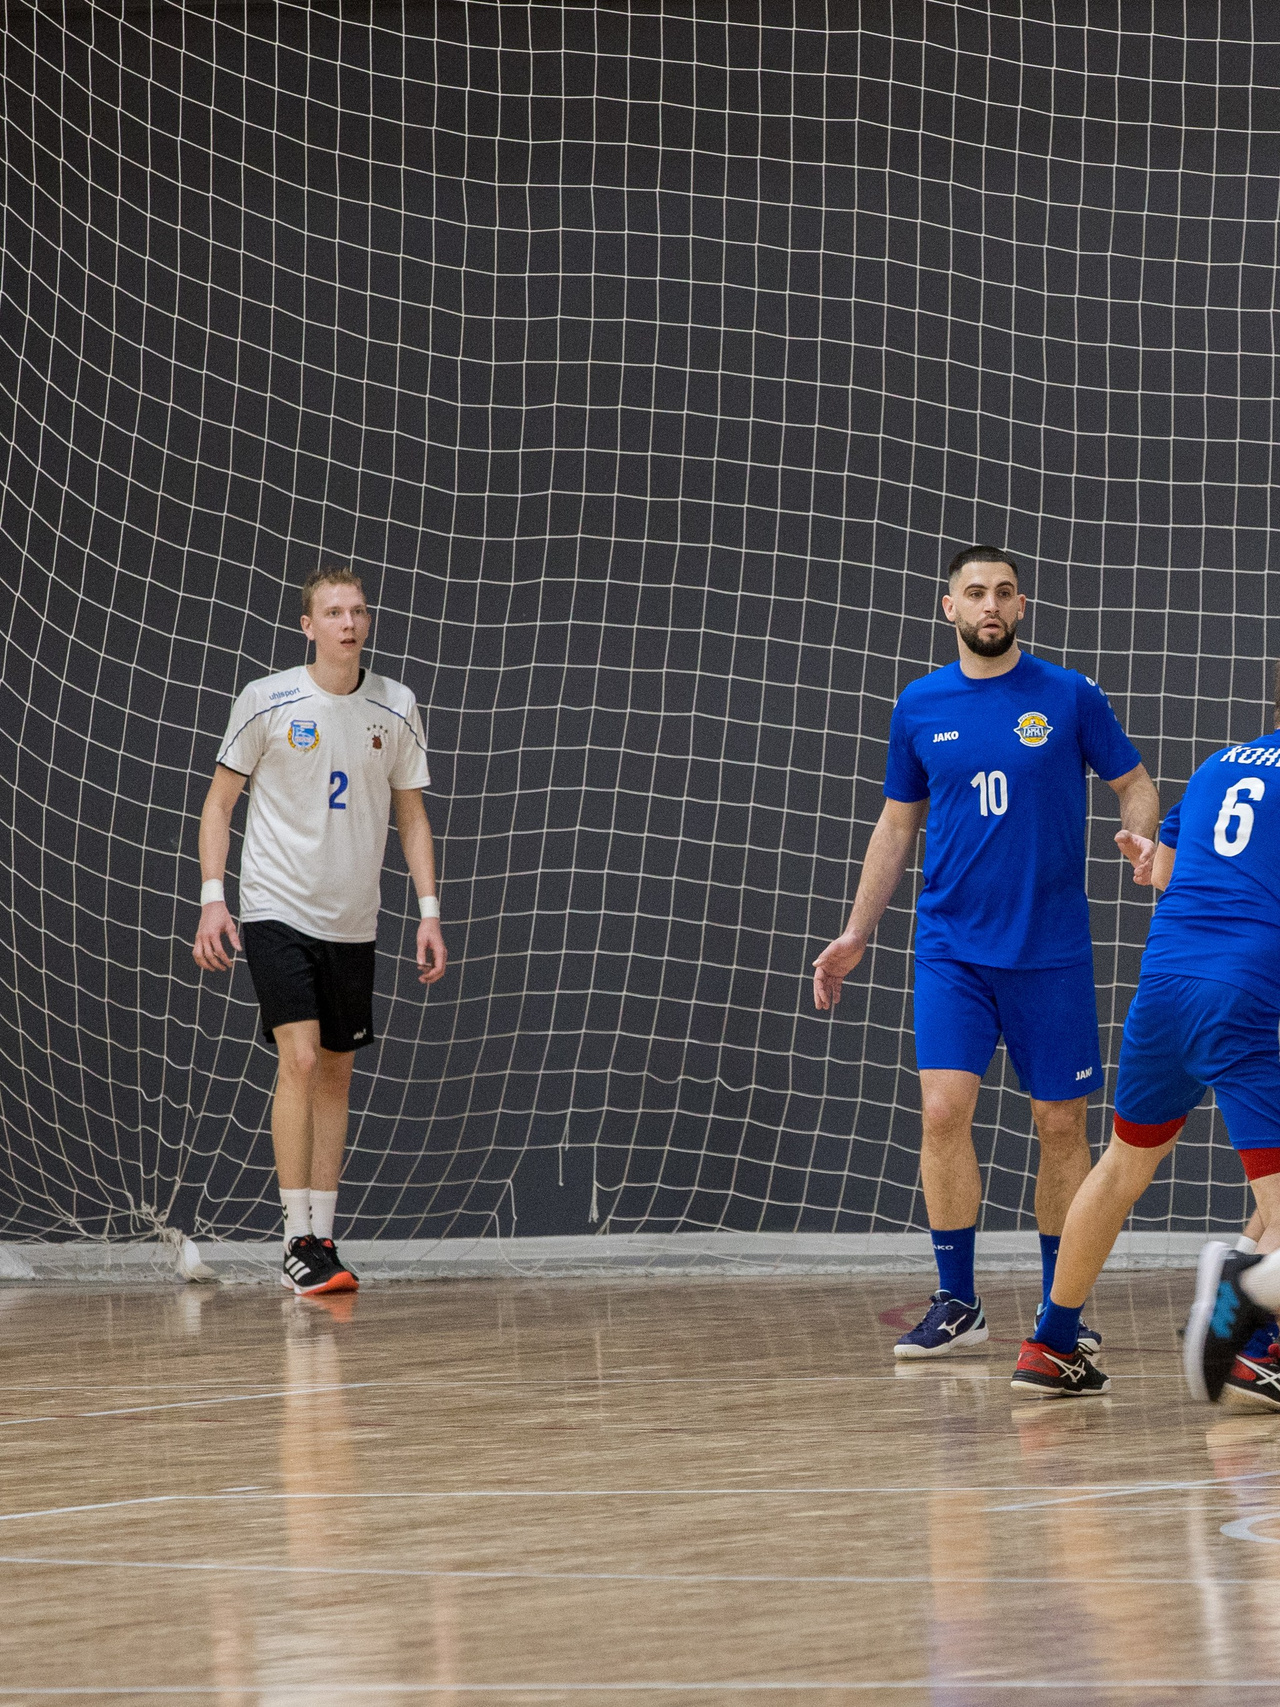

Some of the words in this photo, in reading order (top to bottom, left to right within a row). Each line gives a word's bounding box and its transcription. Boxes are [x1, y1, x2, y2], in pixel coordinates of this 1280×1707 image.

[933, 731, 959, 743] JAKO
[329, 771, 348, 809] 2
[970, 770, 1008, 816] 10
[1214, 777, 1265, 857] 6
